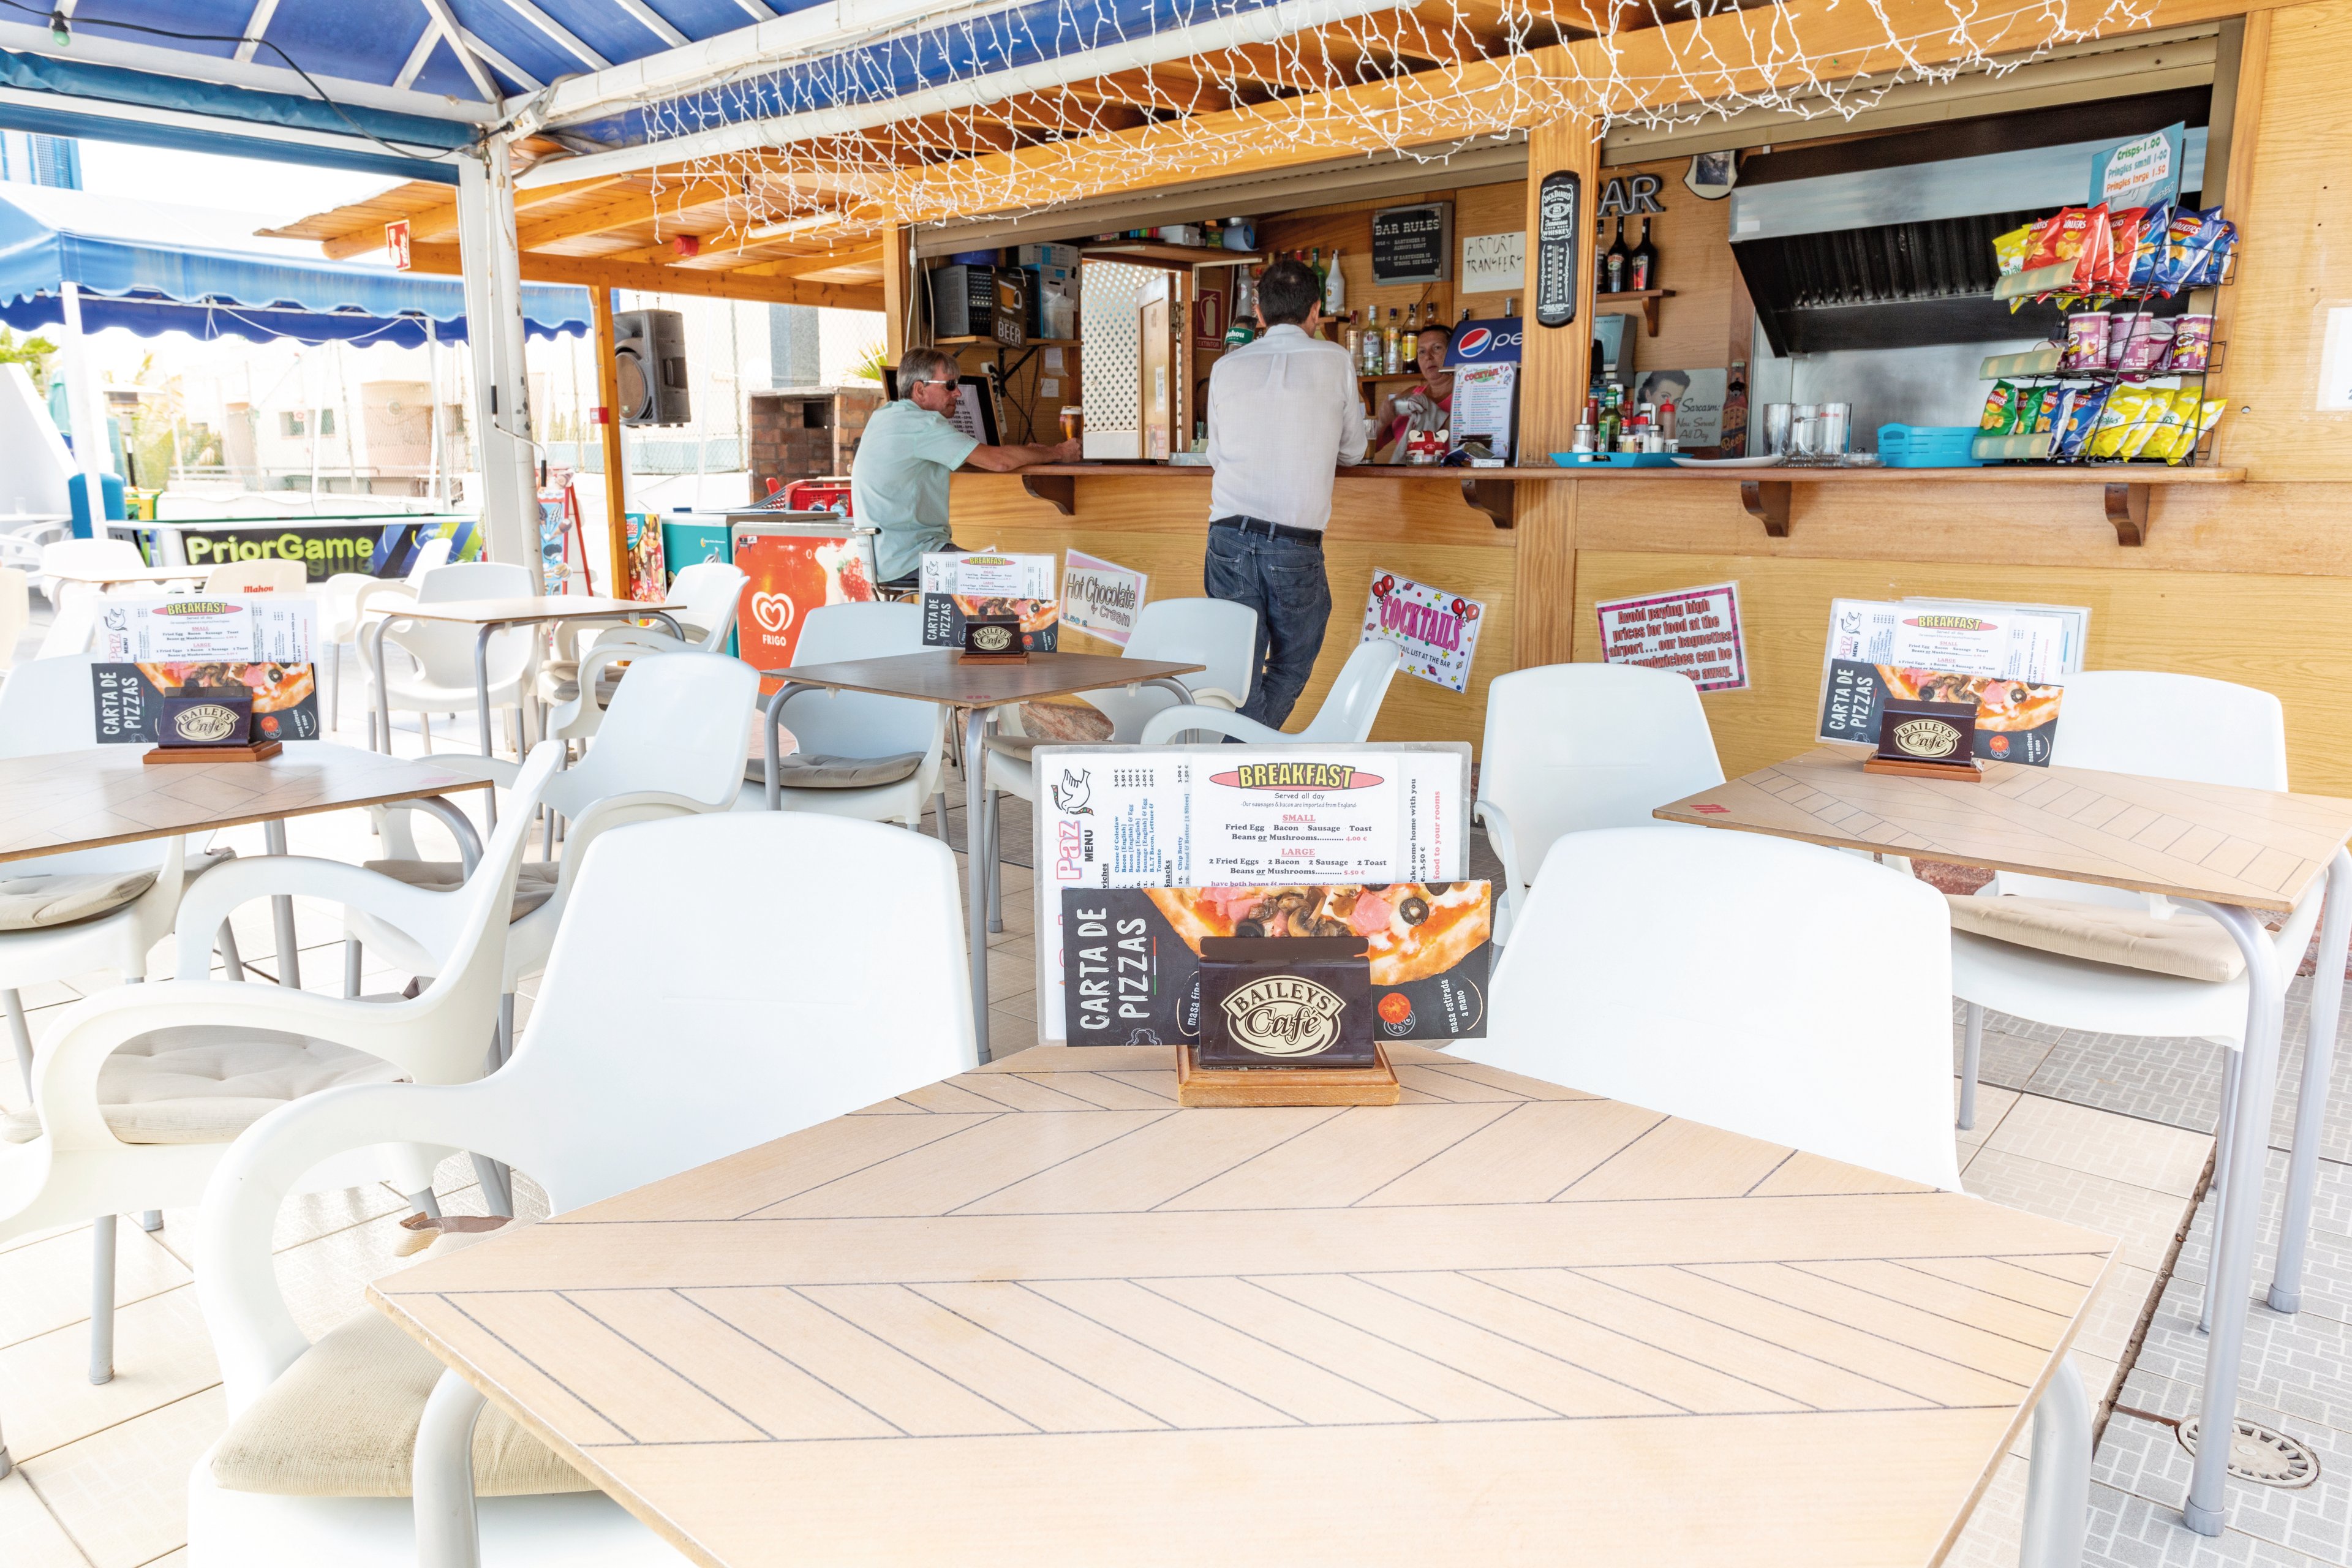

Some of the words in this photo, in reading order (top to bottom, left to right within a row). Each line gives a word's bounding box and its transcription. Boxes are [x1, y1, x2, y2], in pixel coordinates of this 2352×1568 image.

[2108, 164, 2132, 178] Pringles
[2135, 156, 2150, 169] small
[2106, 178, 2130, 192] Pringles
[2133, 172, 2149, 183] large
[2152, 165, 2165, 176] 1.50
[1375, 224, 1400, 235] BAR
[1403, 219, 1439, 232] RULES
[2064, 220, 2086, 229] WALKERS
[2170, 222, 2201, 234] WALKERS
[998, 321, 1020, 344] BEER
[2174, 345, 2195, 358] Pringles
[1682, 398, 1721, 412] Sarcasm:
[1721, 434, 1746, 451] Beer
[186, 533, 374, 564] PriorGame
[969, 557, 1006, 565] BREAKFAST
[1066, 573, 1084, 600] Hot
[1086, 576, 1135, 609] Chocolate
[167, 602, 227, 616] BREAKFAST
[929, 599, 939, 611] DE
[1618, 608, 1646, 624] Avoid
[1648, 603, 1683, 621] paying
[1685, 598, 1710, 616] high
[927, 611, 939, 640] CARTA
[940, 603, 951, 638] PIZZAS
[1381, 595, 1463, 652] COCKTAILS
[1613, 627, 1645, 643] prices
[1646, 624, 1661, 636] for
[1664, 619, 1687, 633] food
[1689, 619, 1700, 630] at
[1702, 616, 1719, 629] the
[1918, 616, 1982, 631] BREAKFAST
[763, 634, 786, 646] FRIGO
[976, 628, 1007, 637] BAILEYS
[979, 635, 1004, 647] Café
[1659, 639, 1676, 651] our
[1678, 631, 1733, 648] baguettes
[1411, 649, 1422, 657] LIST
[1430, 655, 1439, 664] THE
[1440, 660, 1450, 668] BAR
[1696, 650, 1717, 663] can
[1717, 647, 1732, 660] be
[100, 672, 118, 687] DE
[1702, 666, 1733, 679] away.
[1836, 668, 1854, 685] DE
[121, 677, 141, 729] PIZZAS
[1829, 688, 1852, 730] CARTA
[1850, 676, 1873, 728] PIZZAS
[102, 692, 120, 734] CARTA
[181, 707, 232, 723] BAILEYS
[186, 718, 225, 736] Café
[1901, 722, 1955, 737] BAILEYS
[1905, 731, 1947, 752] Café
[1238, 763, 1355, 790] BREAKFAST
[1056, 820, 1082, 880] Paz
[1084, 829, 1093, 862] MENU
[1434, 847, 1440, 856] to
[1076, 907, 1108, 937] DE
[1117, 918, 1150, 1019] PIZZAS
[1079, 946, 1110, 1030] CARTA
[1233, 982, 1332, 1012] BAILEYS
[1441, 979, 1455, 1008] estirada
[1457, 990, 1469, 1010] mano
[1187, 1002, 1199, 1025] masa
[1449, 1009, 1459, 1033] masa
[1245, 1006, 1321, 1045] Café
